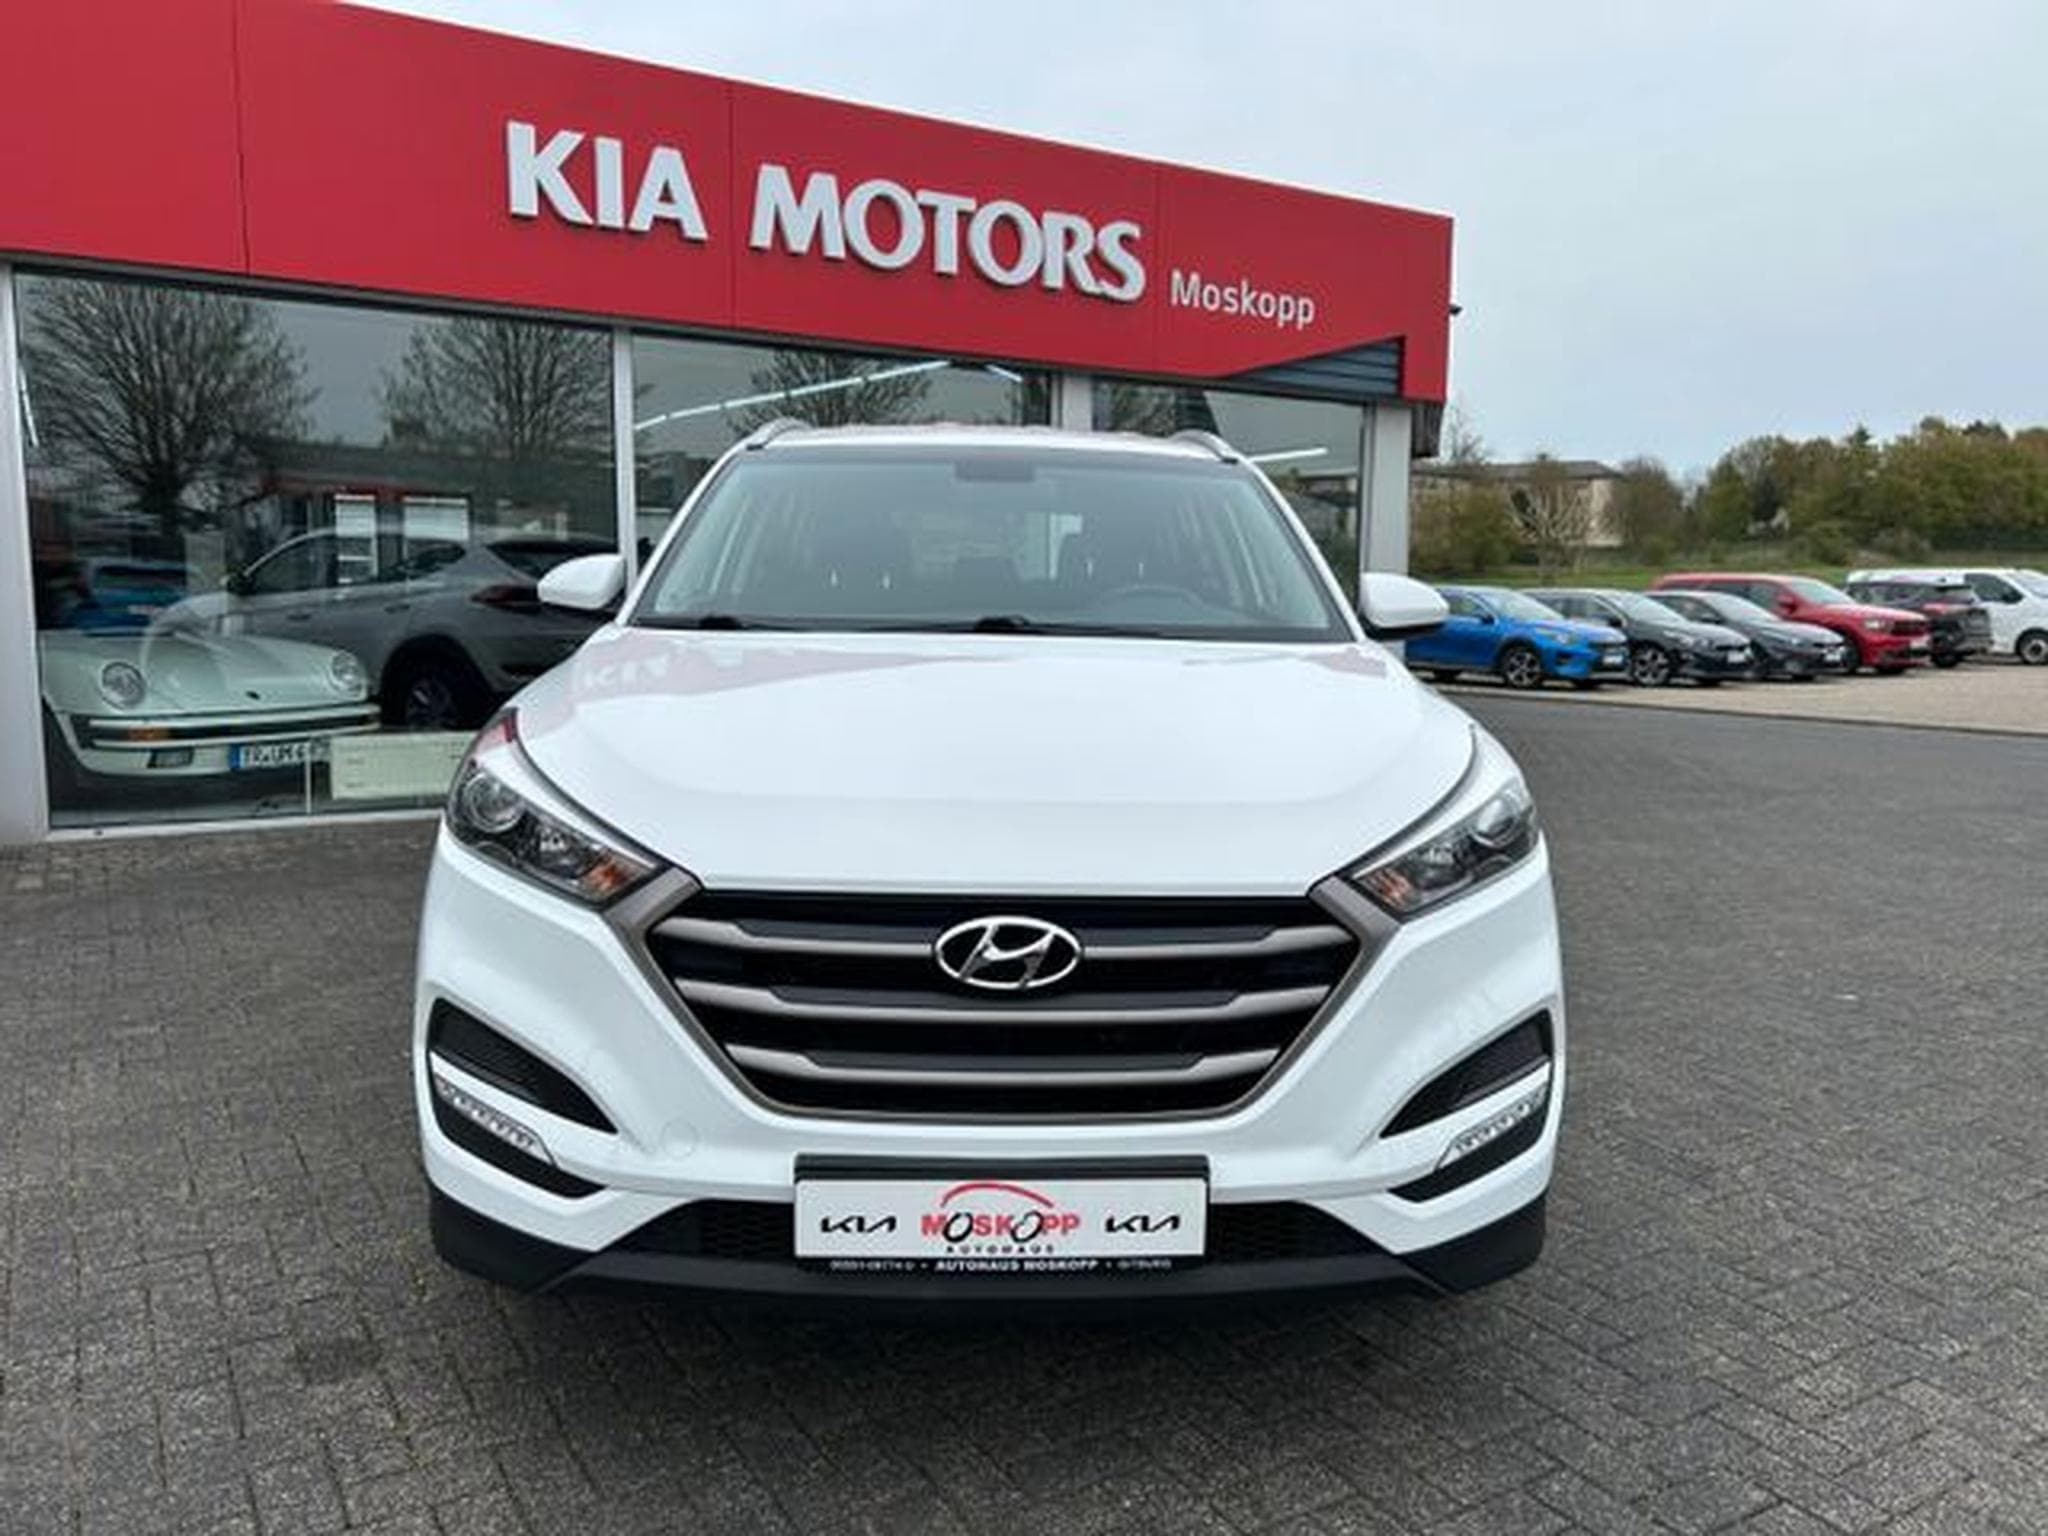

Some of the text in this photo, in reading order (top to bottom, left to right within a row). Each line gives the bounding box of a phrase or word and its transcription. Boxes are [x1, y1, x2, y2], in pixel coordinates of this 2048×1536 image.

[506, 121, 1146, 303] KIA MOTORS
[1170, 270, 1316, 329] Moskopp
[820, 1214, 896, 1235] KIA
[921, 1210, 1081, 1244] MOSKOPP
[1105, 1213, 1180, 1233] KIA
